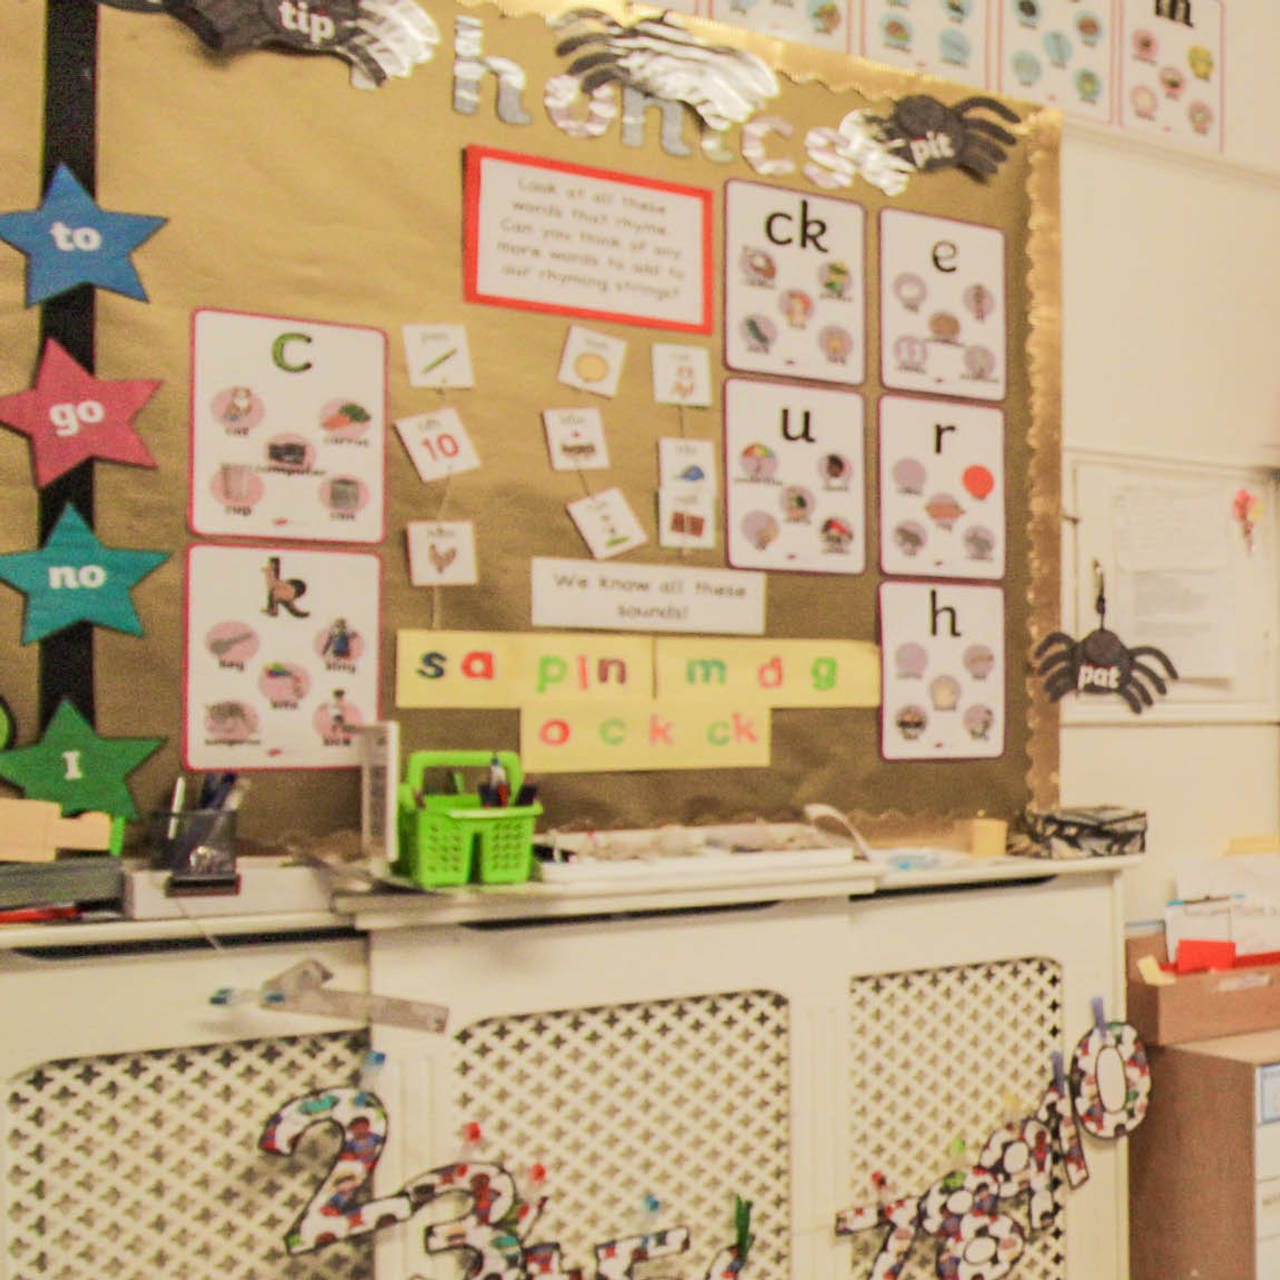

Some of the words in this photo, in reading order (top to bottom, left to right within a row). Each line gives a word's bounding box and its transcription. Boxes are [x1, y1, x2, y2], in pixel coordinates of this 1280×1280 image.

[278, 0, 336, 44] tip
[910, 130, 955, 168] pit
[50, 221, 102, 252] to
[765, 200, 829, 253] ck
[932, 240, 958, 273] e
[49, 400, 104, 436] go
[781, 408, 816, 443] u
[421, 432, 460, 461] 10
[933, 423, 957, 454] r
[49, 564, 106, 590] no
[260, 556, 311, 619] k
[553, 572, 588, 590] We
[599, 575, 650, 595] know
[659, 577, 684, 595] all
[695, 579, 748, 599] these
[931, 588, 962, 638] h
[1077, 663, 1122, 691] pat
[61, 750, 82, 780] I
